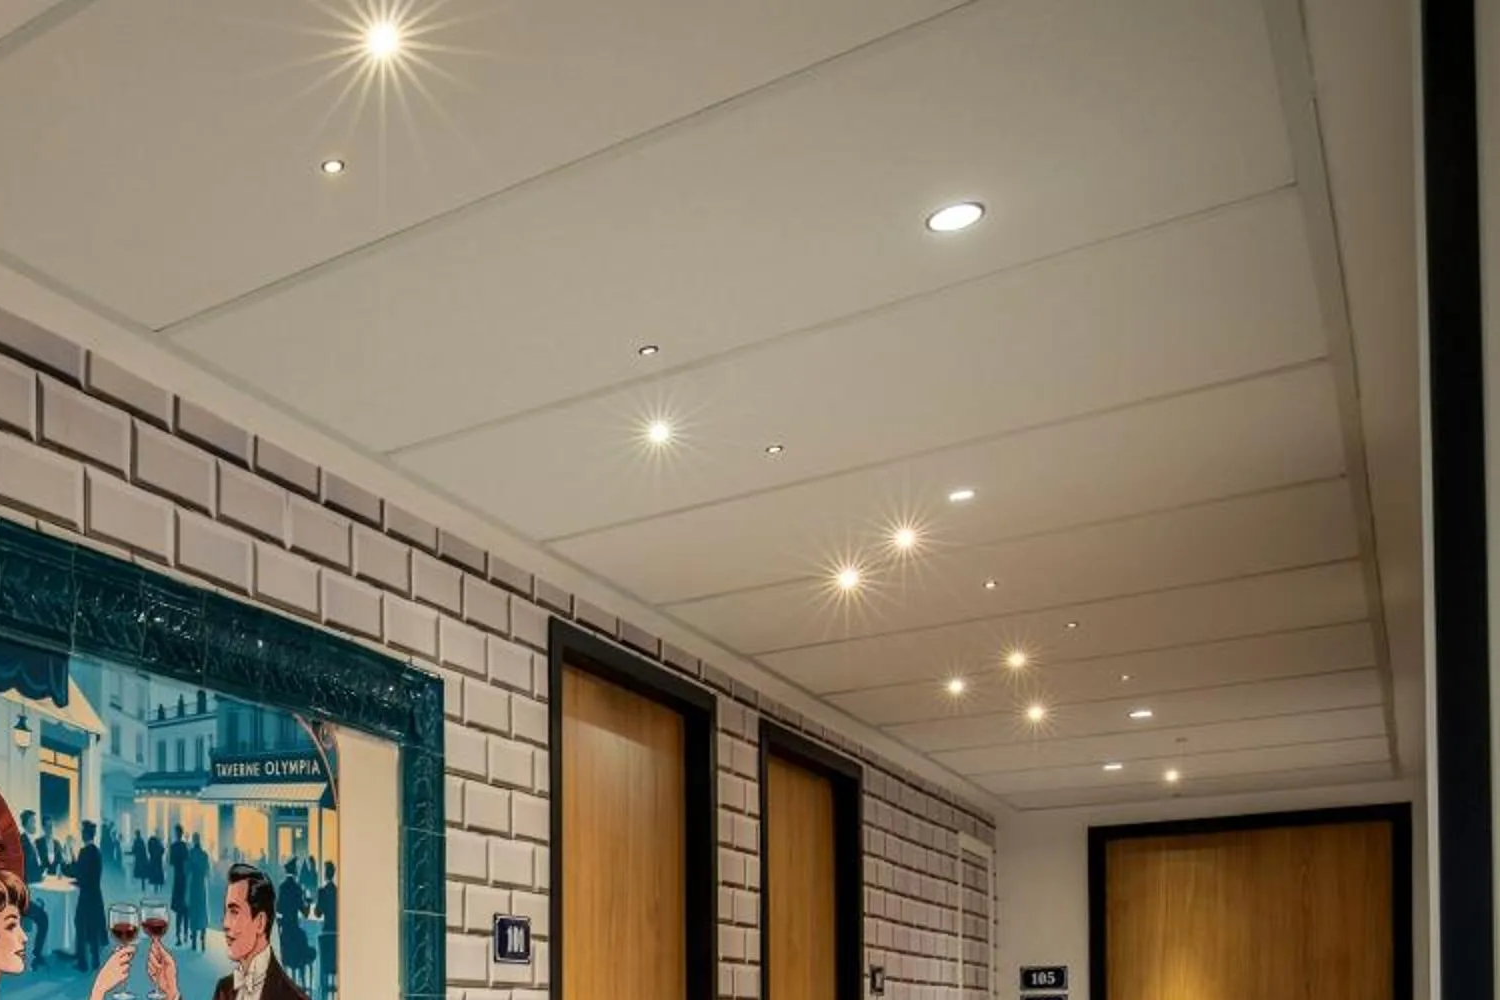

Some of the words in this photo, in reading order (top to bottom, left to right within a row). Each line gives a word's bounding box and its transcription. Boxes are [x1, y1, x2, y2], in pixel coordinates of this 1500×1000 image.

[215, 762, 260, 777] TAVERNE
[264, 759, 320, 776] OLYMPIA
[1031, 971, 1056, 985] 105
